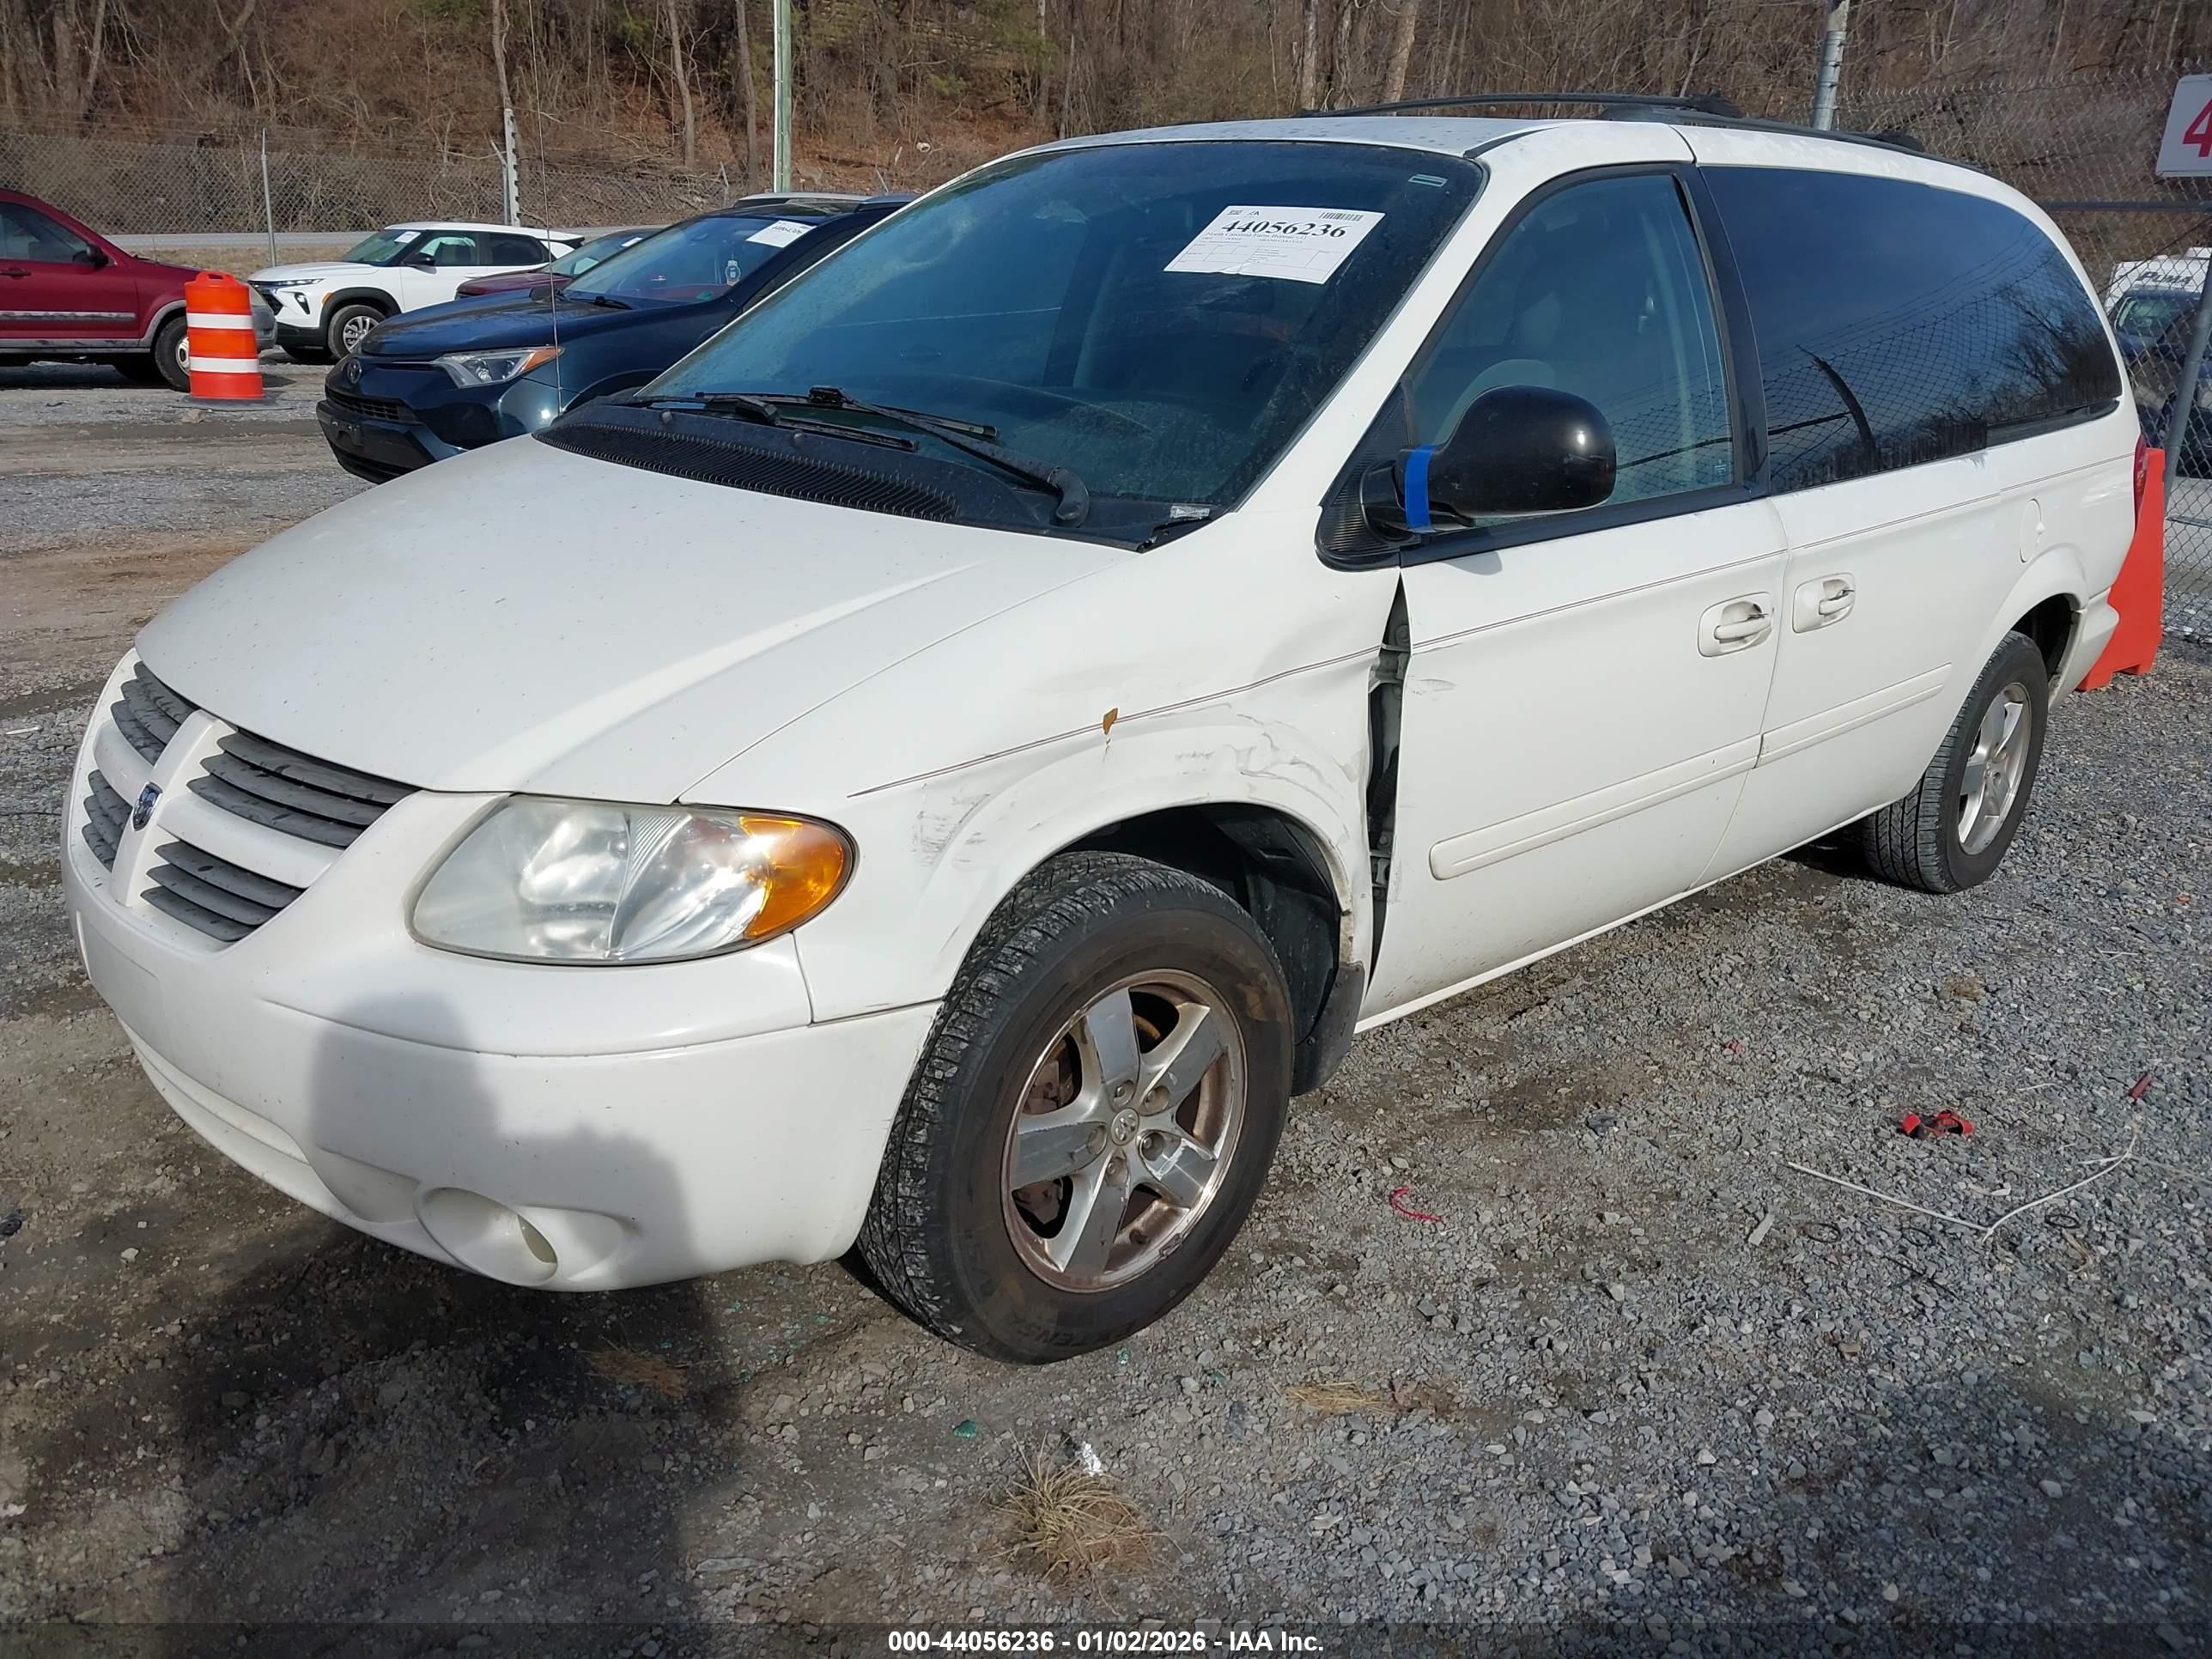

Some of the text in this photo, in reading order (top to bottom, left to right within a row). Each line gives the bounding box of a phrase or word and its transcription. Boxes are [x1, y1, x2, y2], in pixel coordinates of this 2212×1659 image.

[2182, 98, 2212, 158] 4
[1221, 220, 1352, 238] 44056236
[2136, 270, 2193, 284] PUMA
